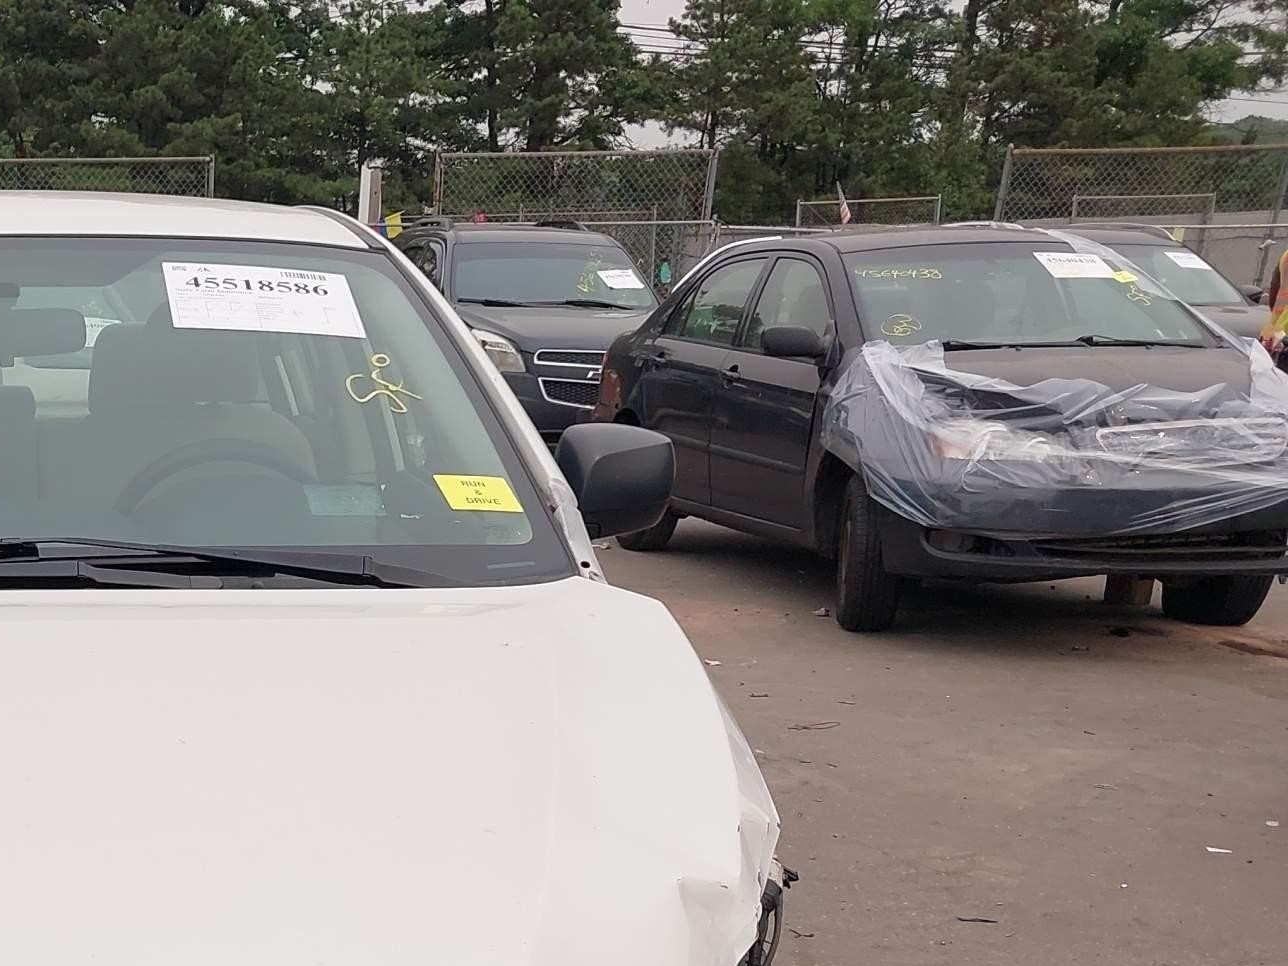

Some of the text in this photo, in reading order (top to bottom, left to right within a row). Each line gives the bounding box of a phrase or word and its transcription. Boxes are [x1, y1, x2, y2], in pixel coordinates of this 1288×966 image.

[185, 276, 329, 297] 45518586
[460, 480, 486, 488] RUN
[465, 497, 502, 505] DRIVE
